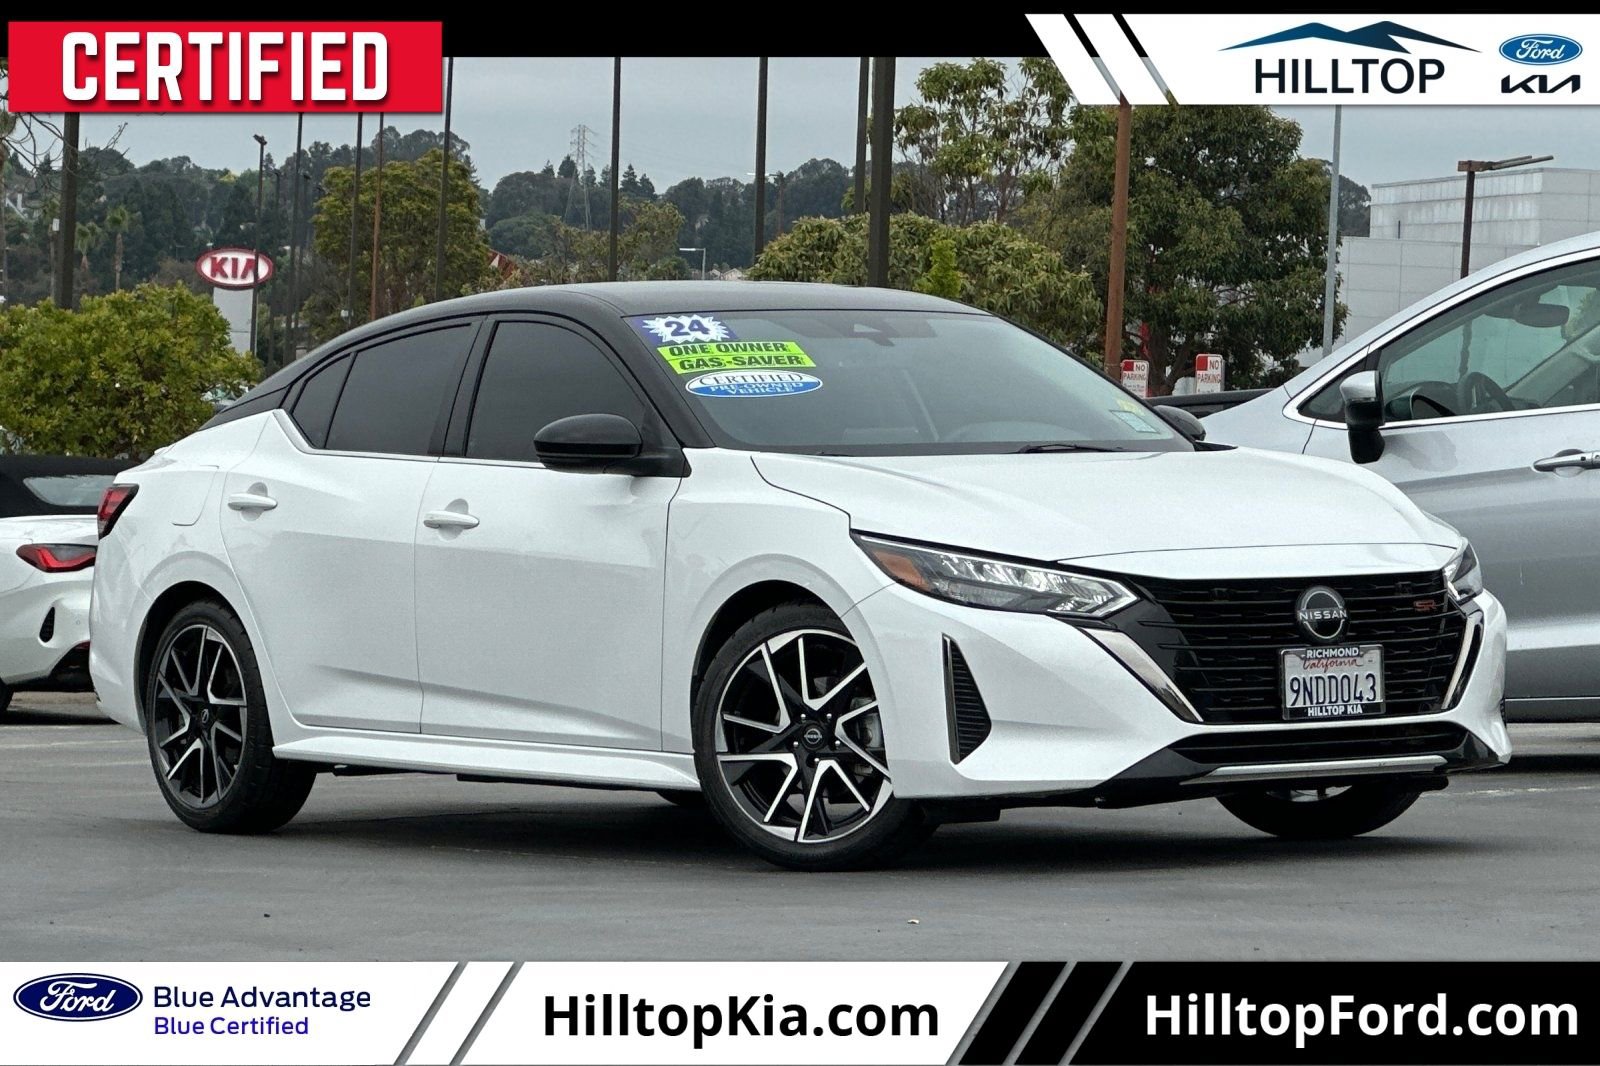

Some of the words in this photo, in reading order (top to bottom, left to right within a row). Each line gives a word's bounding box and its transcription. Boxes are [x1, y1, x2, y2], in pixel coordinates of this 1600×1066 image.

[210, 256, 258, 279] KIA
[664, 320, 710, 336] 24
[668, 343, 711, 357] ONE
[715, 341, 788, 354] OWNER
[679, 355, 803, 370] GAS-SAVER
[1135, 363, 1146, 371] NO
[1209, 360, 1219, 370] NO
[699, 373, 803, 386] CERTIFIED
[1123, 373, 1146, 381] PARKING
[1197, 373, 1221, 383] PARKING
[726, 387, 795, 395] VEHICLE
[1299, 610, 1347, 620] NISSAN
[1306, 647, 1360, 659] RICHMOND
[1303, 659, 1364, 673] California
[1289, 673, 1377, 707] 9NDD043
[1307, 705, 1345, 716] HILLTOP
[1347, 703, 1363, 714] KIA
